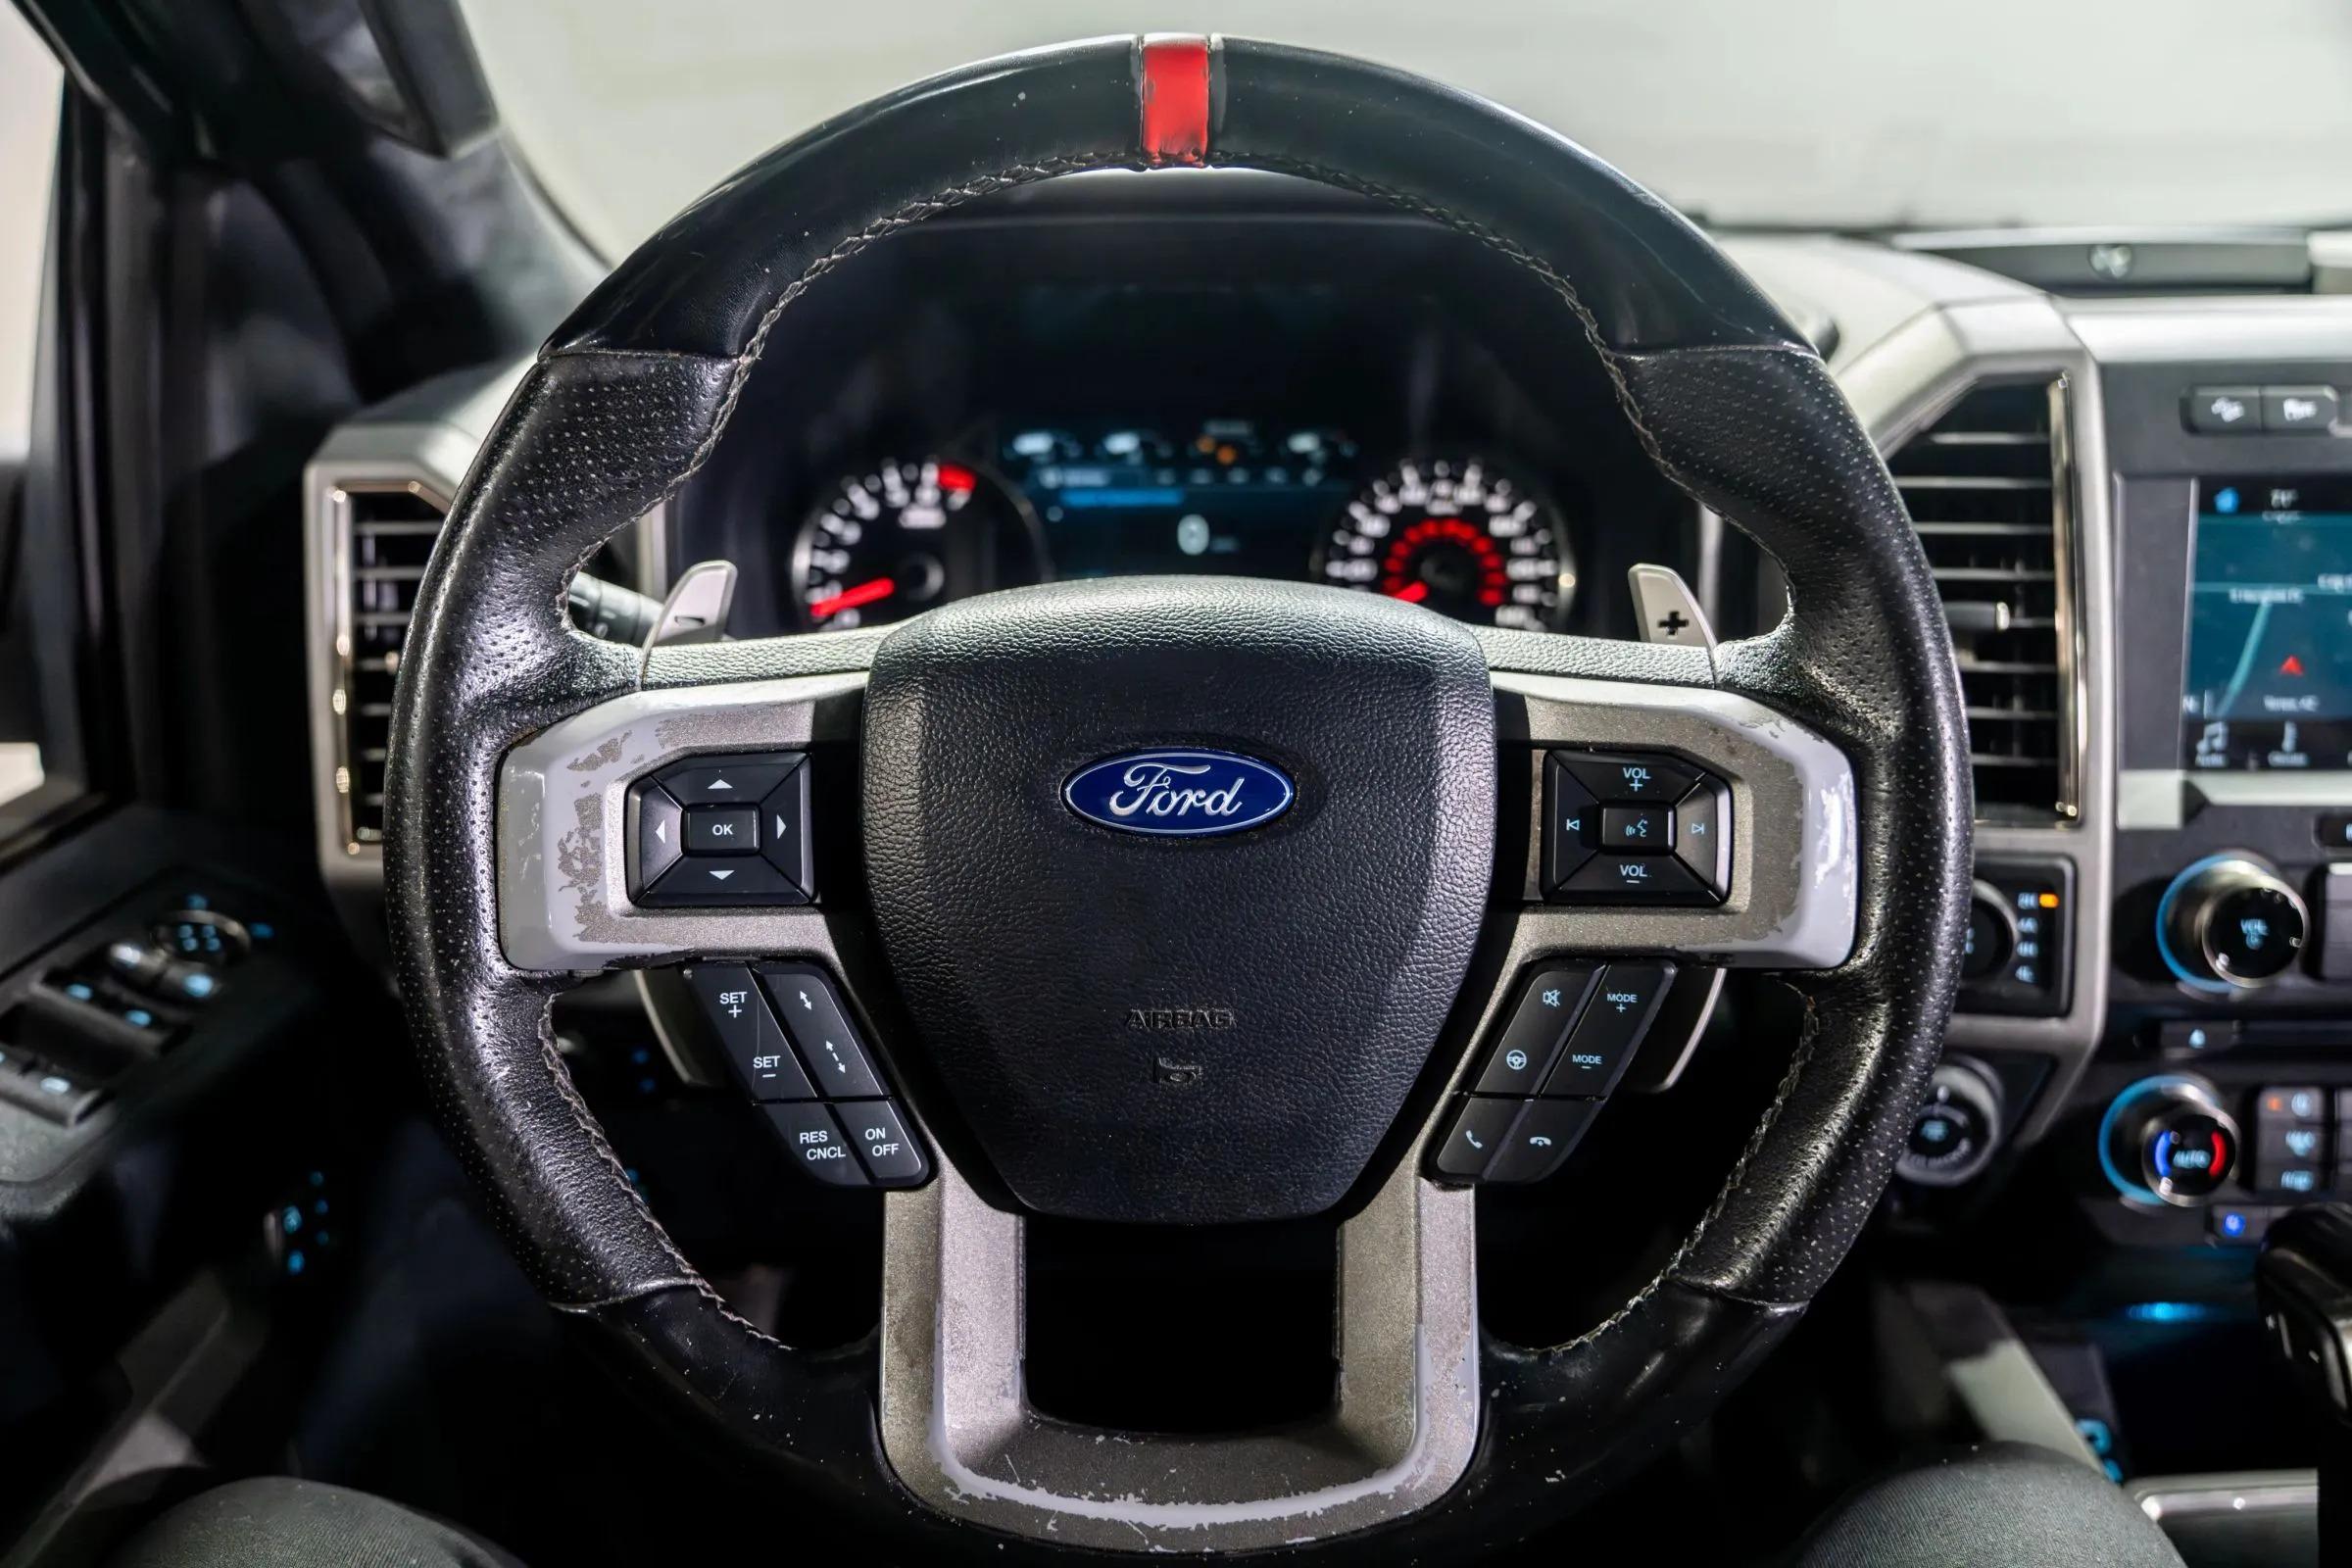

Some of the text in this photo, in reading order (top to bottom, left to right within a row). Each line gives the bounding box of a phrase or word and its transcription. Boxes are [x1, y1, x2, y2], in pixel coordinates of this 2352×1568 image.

[1622, 767, 1651, 780] VOL
[1109, 762, 1245, 816] Ford
[711, 823, 734, 836] OK
[1619, 864, 1648, 877] VOL
[719, 991, 748, 1004] SET
[1606, 992, 1638, 1004] MODE
[1129, 1007, 1235, 1030] AIRBAG
[753, 1054, 781, 1069] SET
[1572, 1054, 1602, 1065] MODE
[799, 1130, 828, 1145] RES
[864, 1127, 886, 1141] ON
[806, 1146, 847, 1161] CNCL
[871, 1143, 900, 1157] OFF
